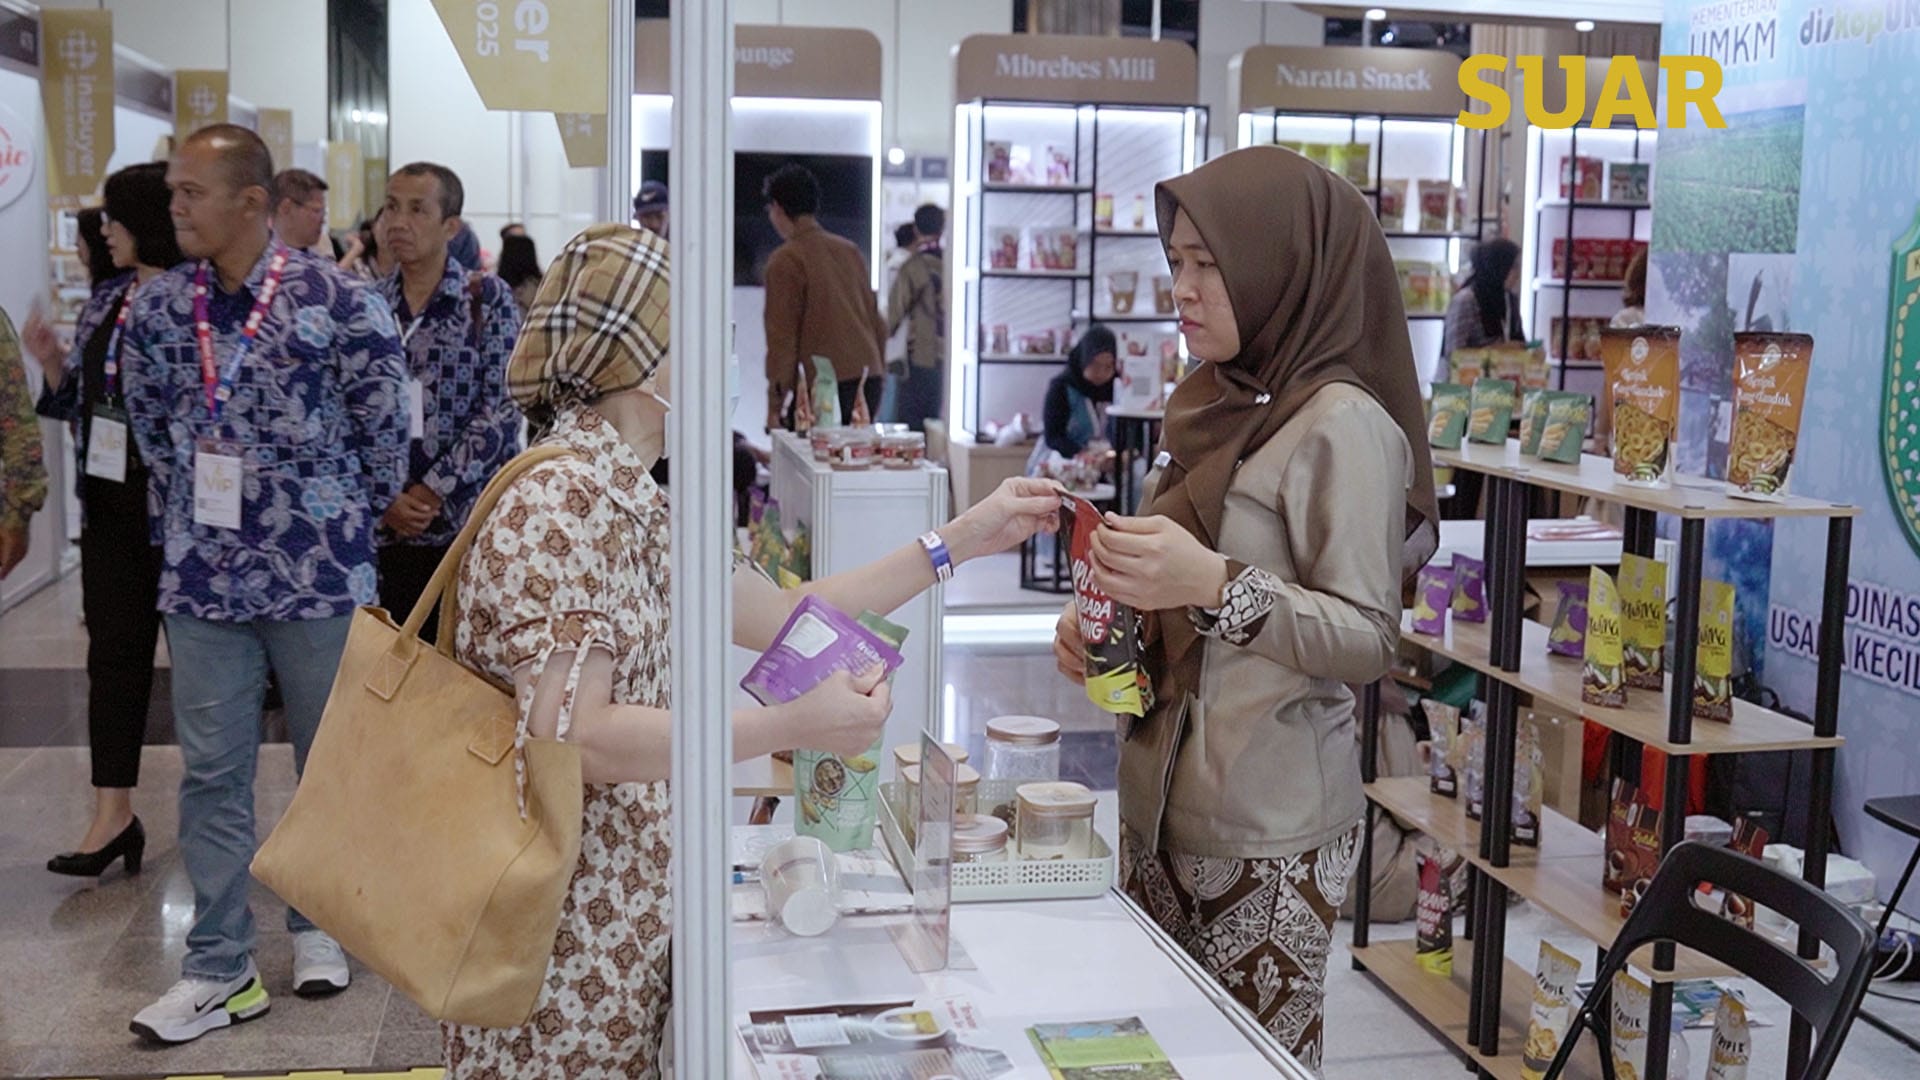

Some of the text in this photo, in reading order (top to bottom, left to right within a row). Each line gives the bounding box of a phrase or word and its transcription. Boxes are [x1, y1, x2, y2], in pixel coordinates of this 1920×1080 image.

[476, 0, 499, 56] 025
[1690, 18, 1776, 66] UMKM
[735, 47, 794, 70] ounge
[995, 52, 1155, 81] Mbrebes Mili
[1277, 64, 1433, 91] Narata Snack
[75, 74, 97, 176] inabuyer
[1845, 584, 1920, 637] DINAS
